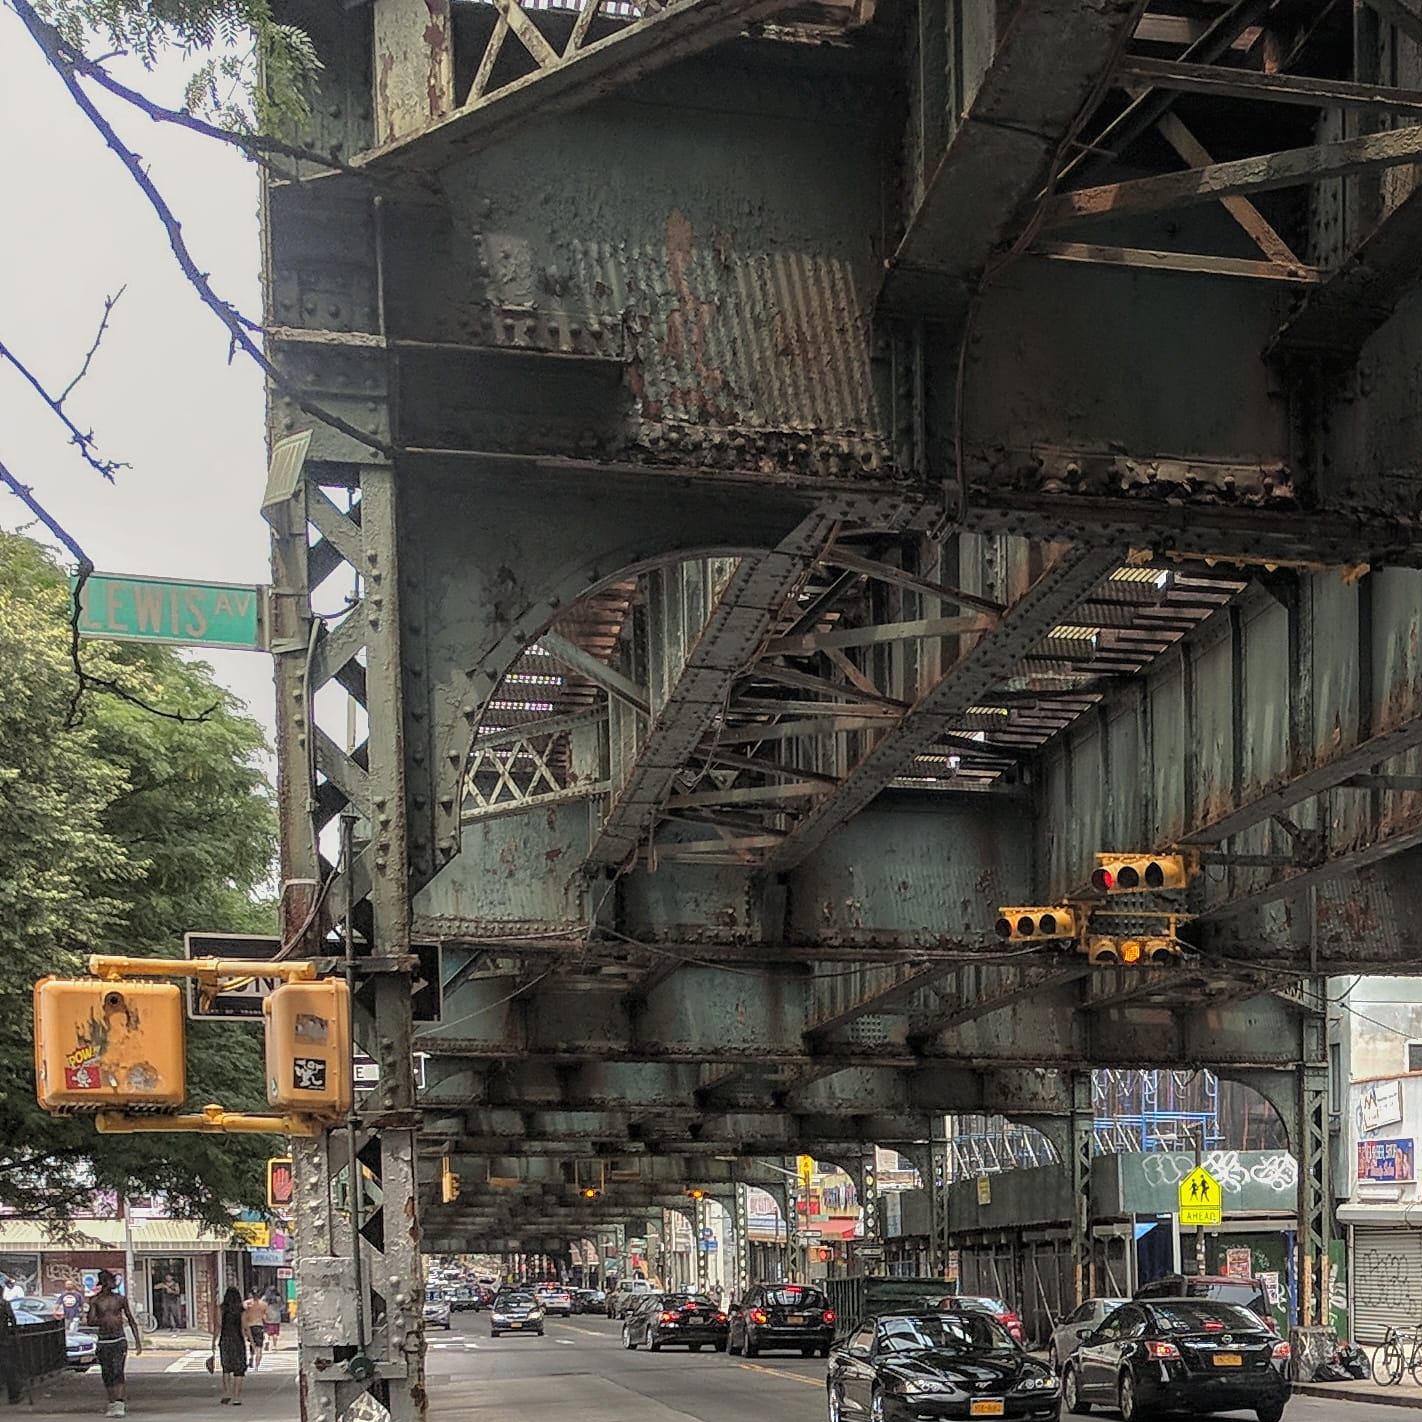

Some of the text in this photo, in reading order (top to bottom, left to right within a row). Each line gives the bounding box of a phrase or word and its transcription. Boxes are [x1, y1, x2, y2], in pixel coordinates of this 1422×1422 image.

[81, 581, 250, 638] LEWIS AV
[1187, 1211, 1216, 1221] AHEAD
